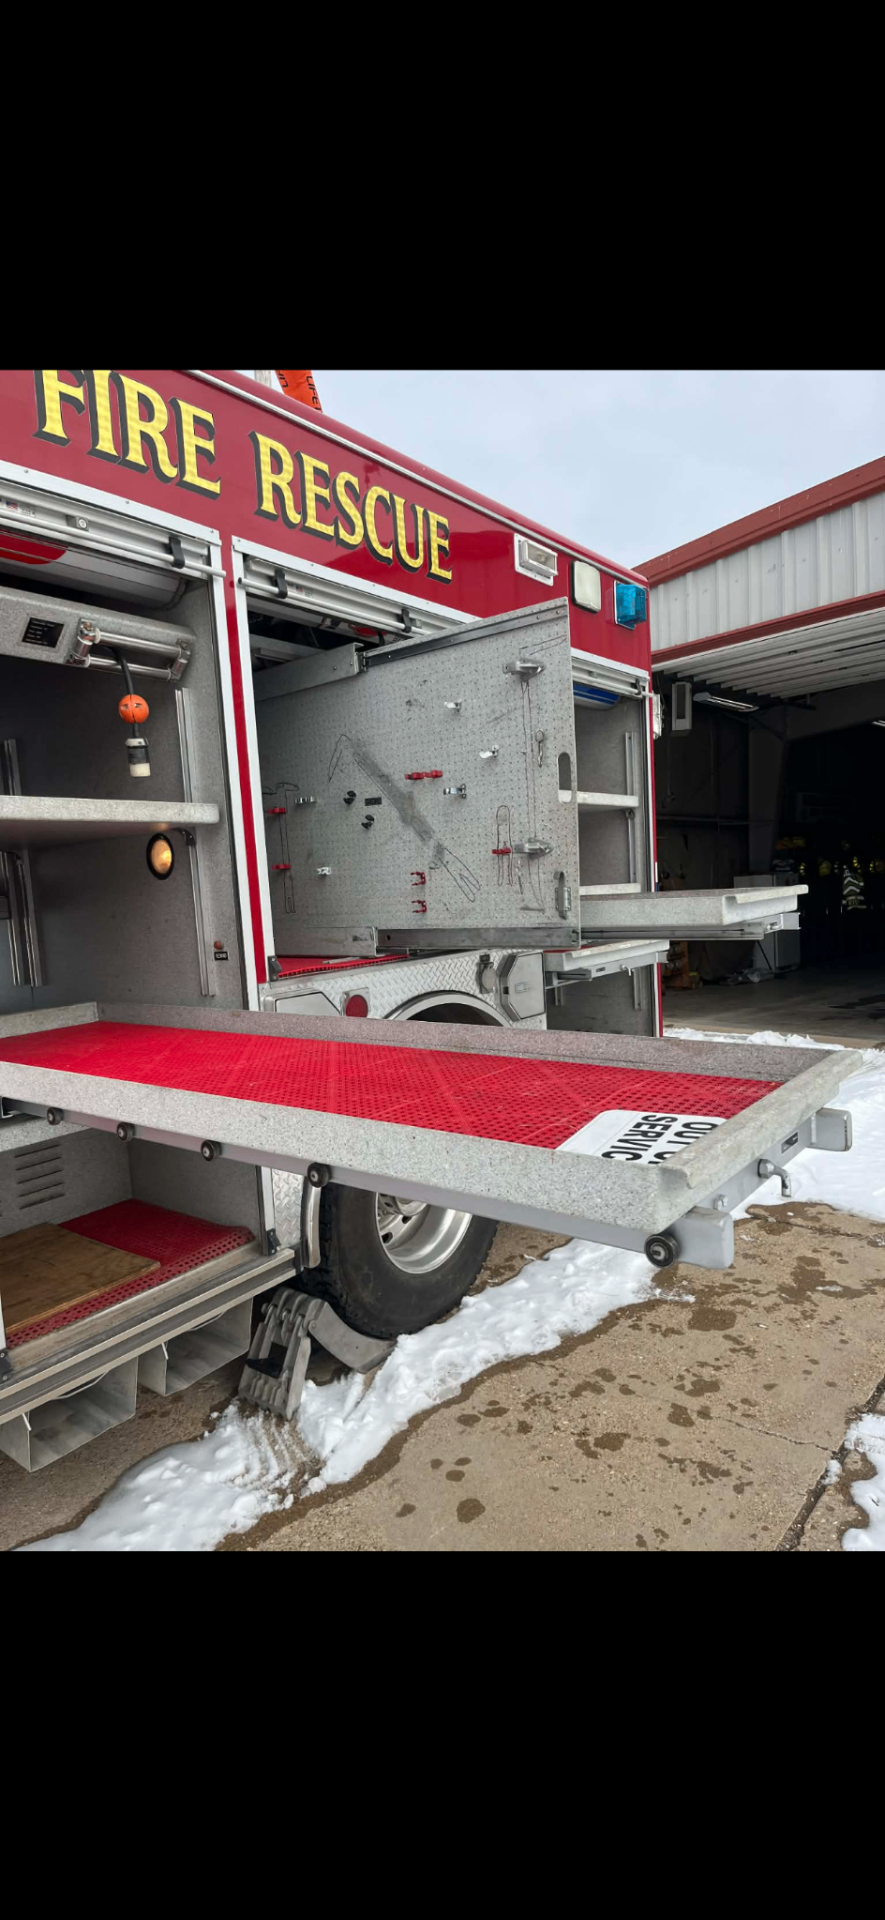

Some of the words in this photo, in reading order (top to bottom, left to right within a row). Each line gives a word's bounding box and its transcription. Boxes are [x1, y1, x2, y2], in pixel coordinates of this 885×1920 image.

[33, 369, 222, 500] FIRE
[248, 430, 454, 586] RESCUE
[601, 1114, 679, 1161] SERVIC
